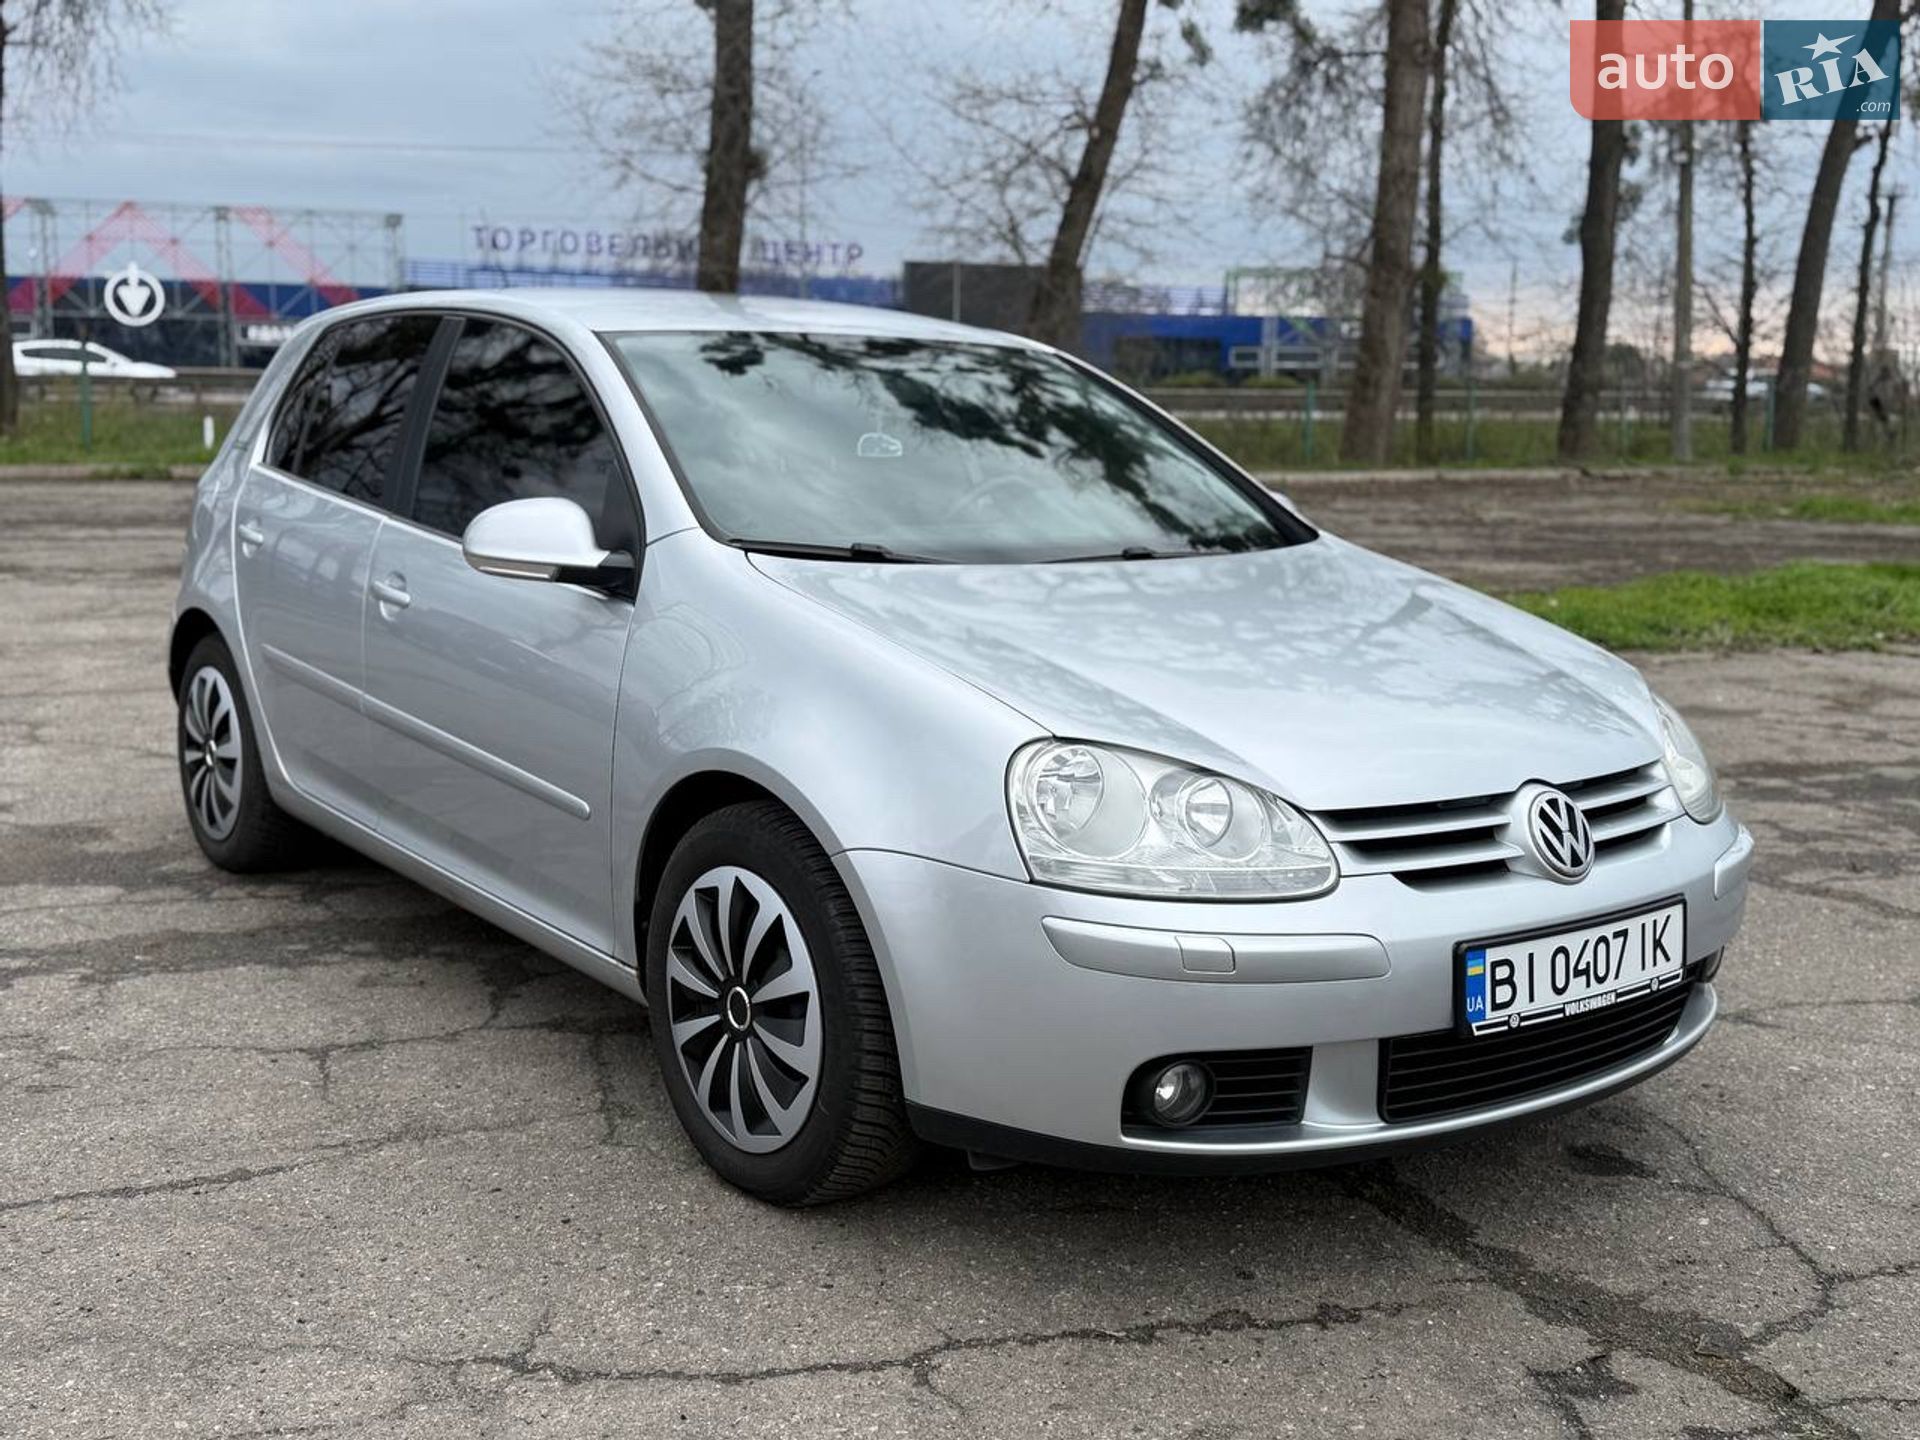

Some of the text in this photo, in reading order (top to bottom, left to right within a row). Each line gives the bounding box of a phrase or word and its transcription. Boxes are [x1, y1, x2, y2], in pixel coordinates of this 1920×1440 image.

[471, 225, 864, 267] ТОРГОВЕЛЬН ЦЕНТР
[1489, 914, 1672, 1012] BI 0407 IK
[1466, 995, 1485, 1013] UA
[1564, 991, 1617, 1017] VOLKSWAGEN
